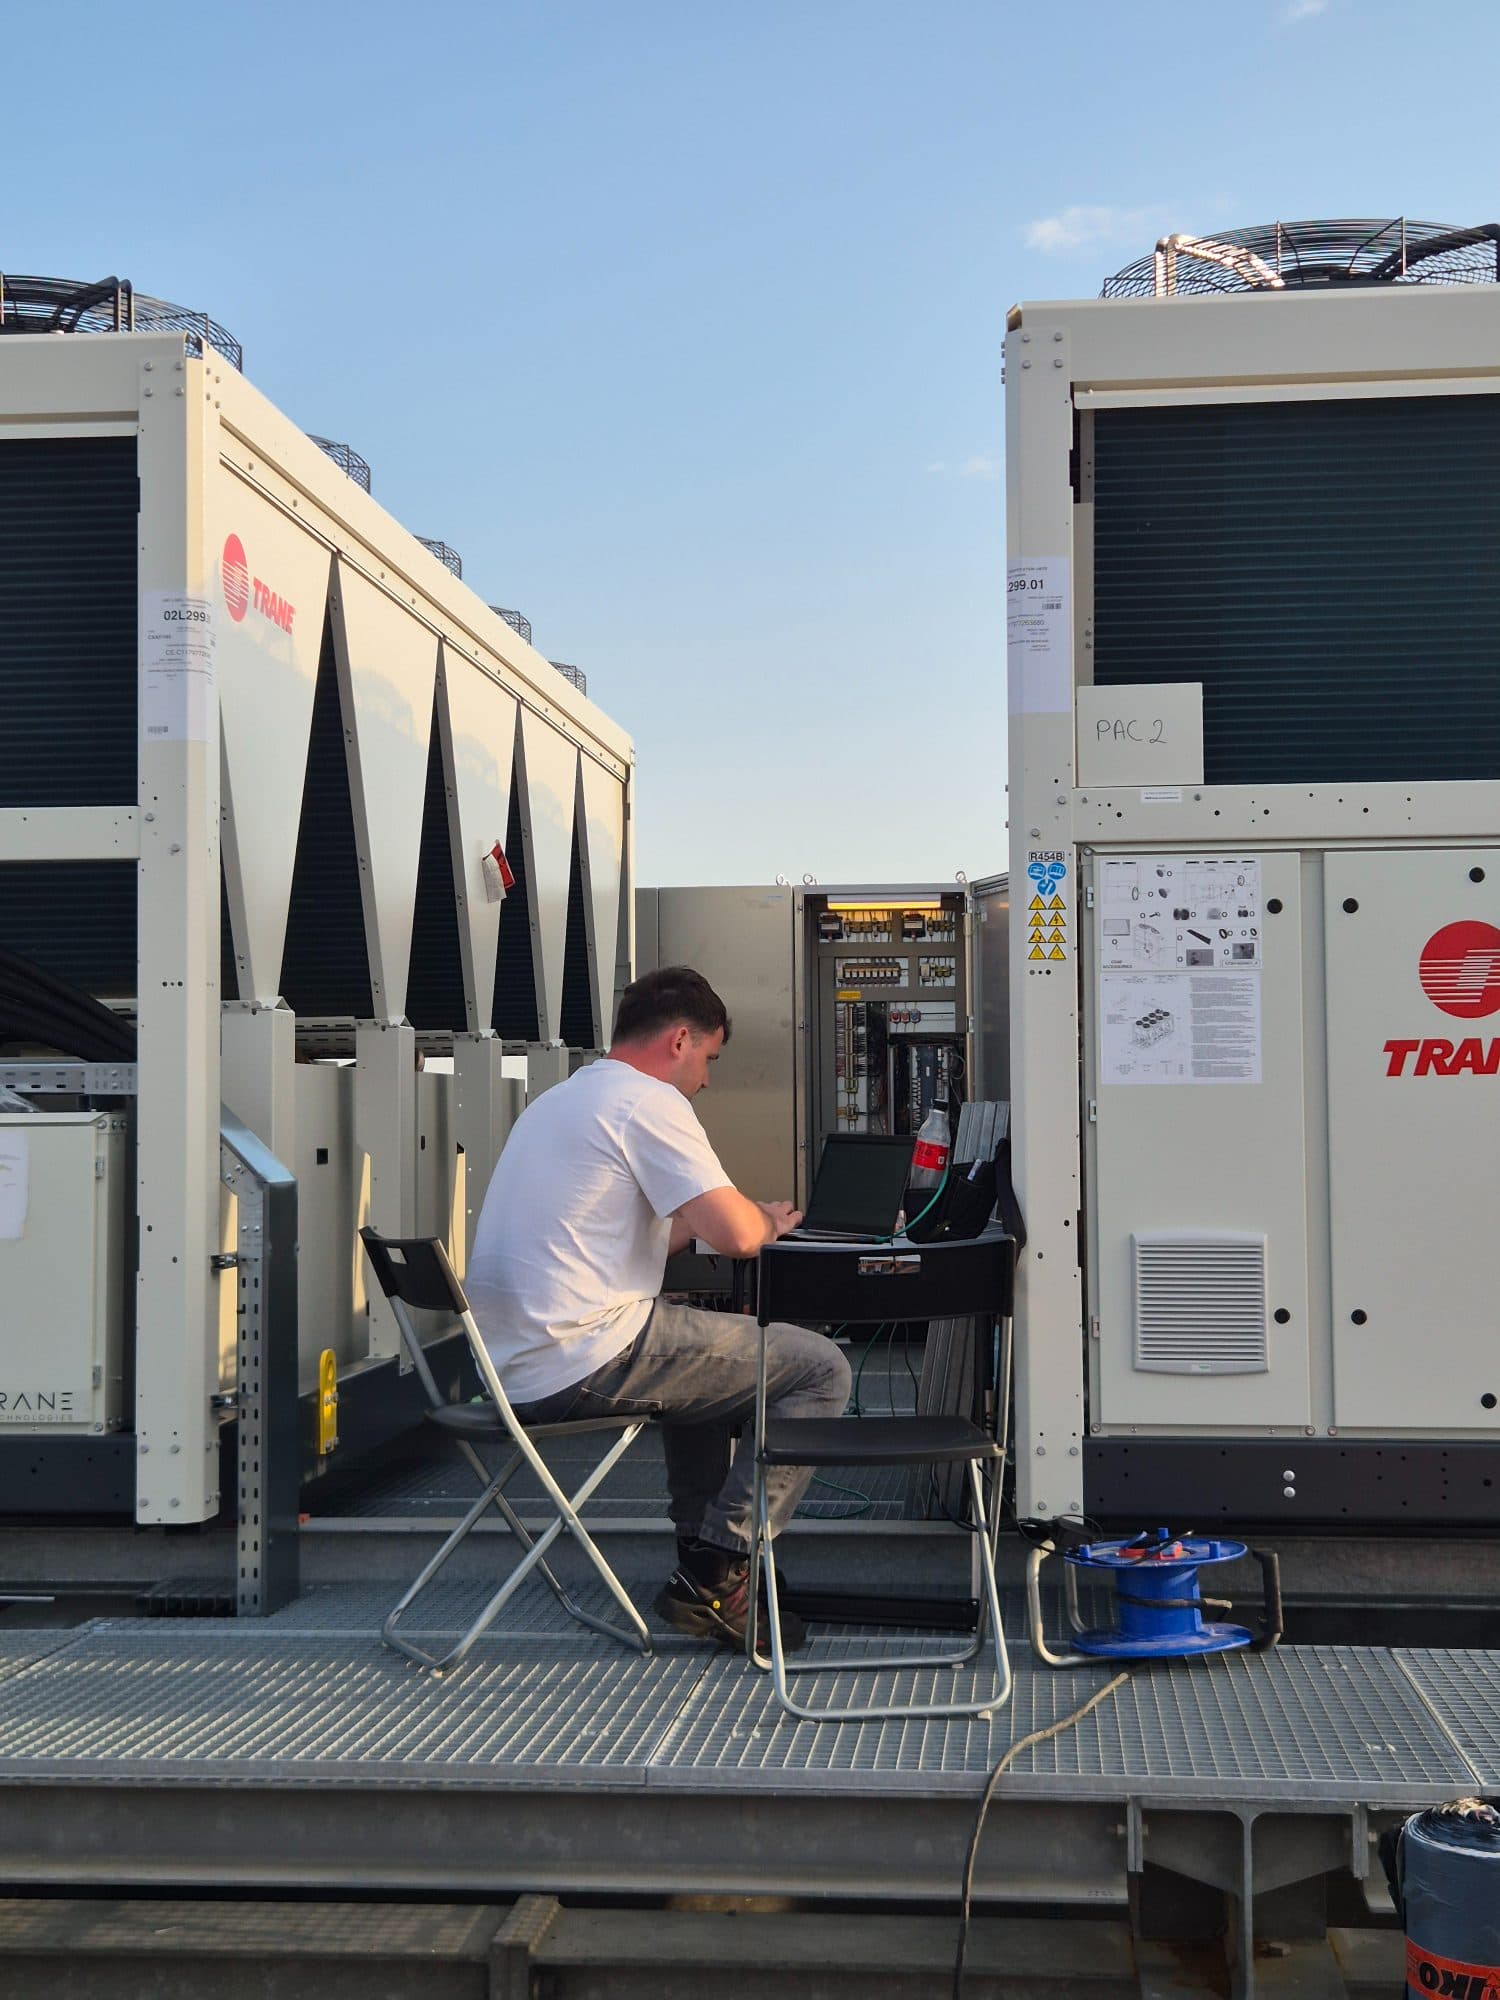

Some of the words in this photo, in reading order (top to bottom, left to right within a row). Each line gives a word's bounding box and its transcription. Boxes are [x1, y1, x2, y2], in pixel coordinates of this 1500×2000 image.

[1006, 579, 1044, 593] 299.01
[252, 576, 296, 635] TRANE
[1096, 718, 1143, 742] PAC
[1148, 718, 1168, 744] 2
[1030, 852, 1063, 861] R454B
